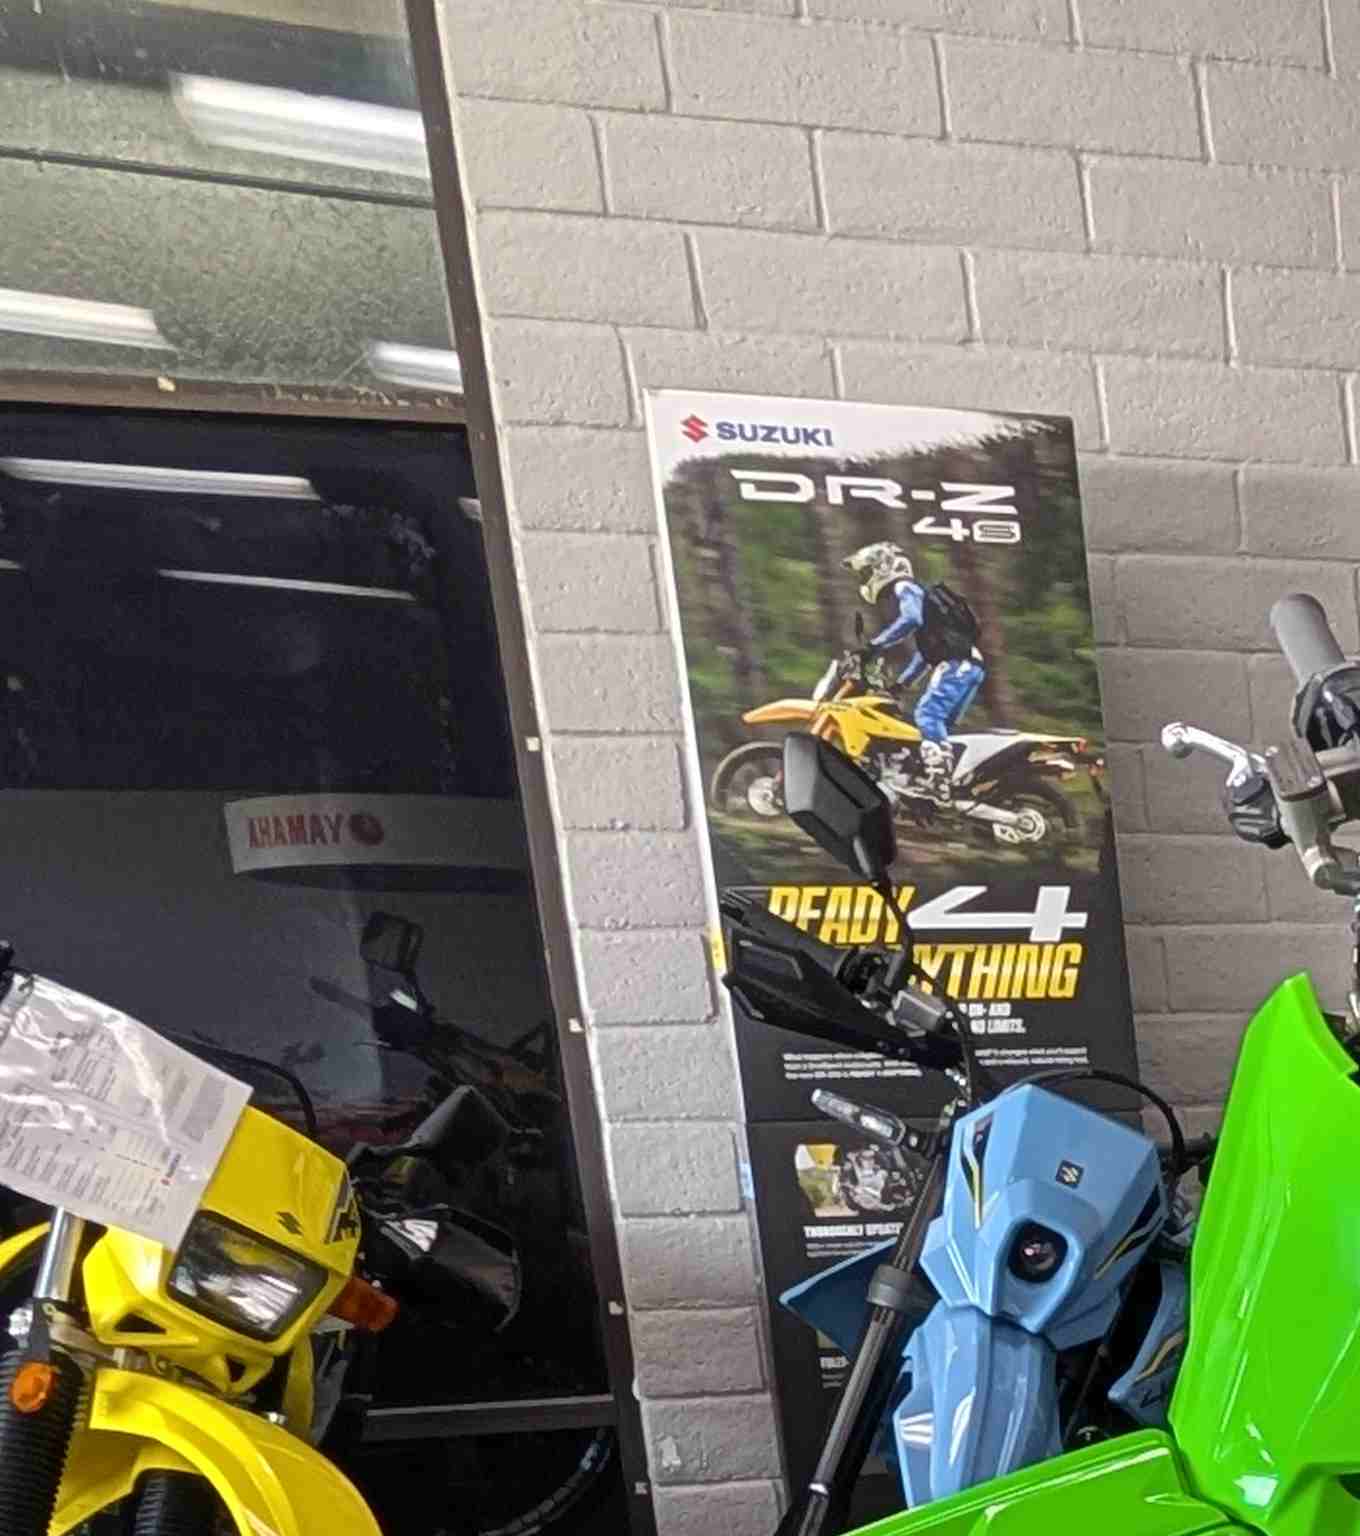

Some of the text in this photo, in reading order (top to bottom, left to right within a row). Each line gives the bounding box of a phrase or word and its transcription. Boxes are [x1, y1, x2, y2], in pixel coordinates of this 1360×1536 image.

[715, 421, 834, 447] SUZUKI
[729, 469, 1019, 514] DR-Z
[906, 885, 1089, 942] 4
[911, 942, 1082, 999] YTHING
